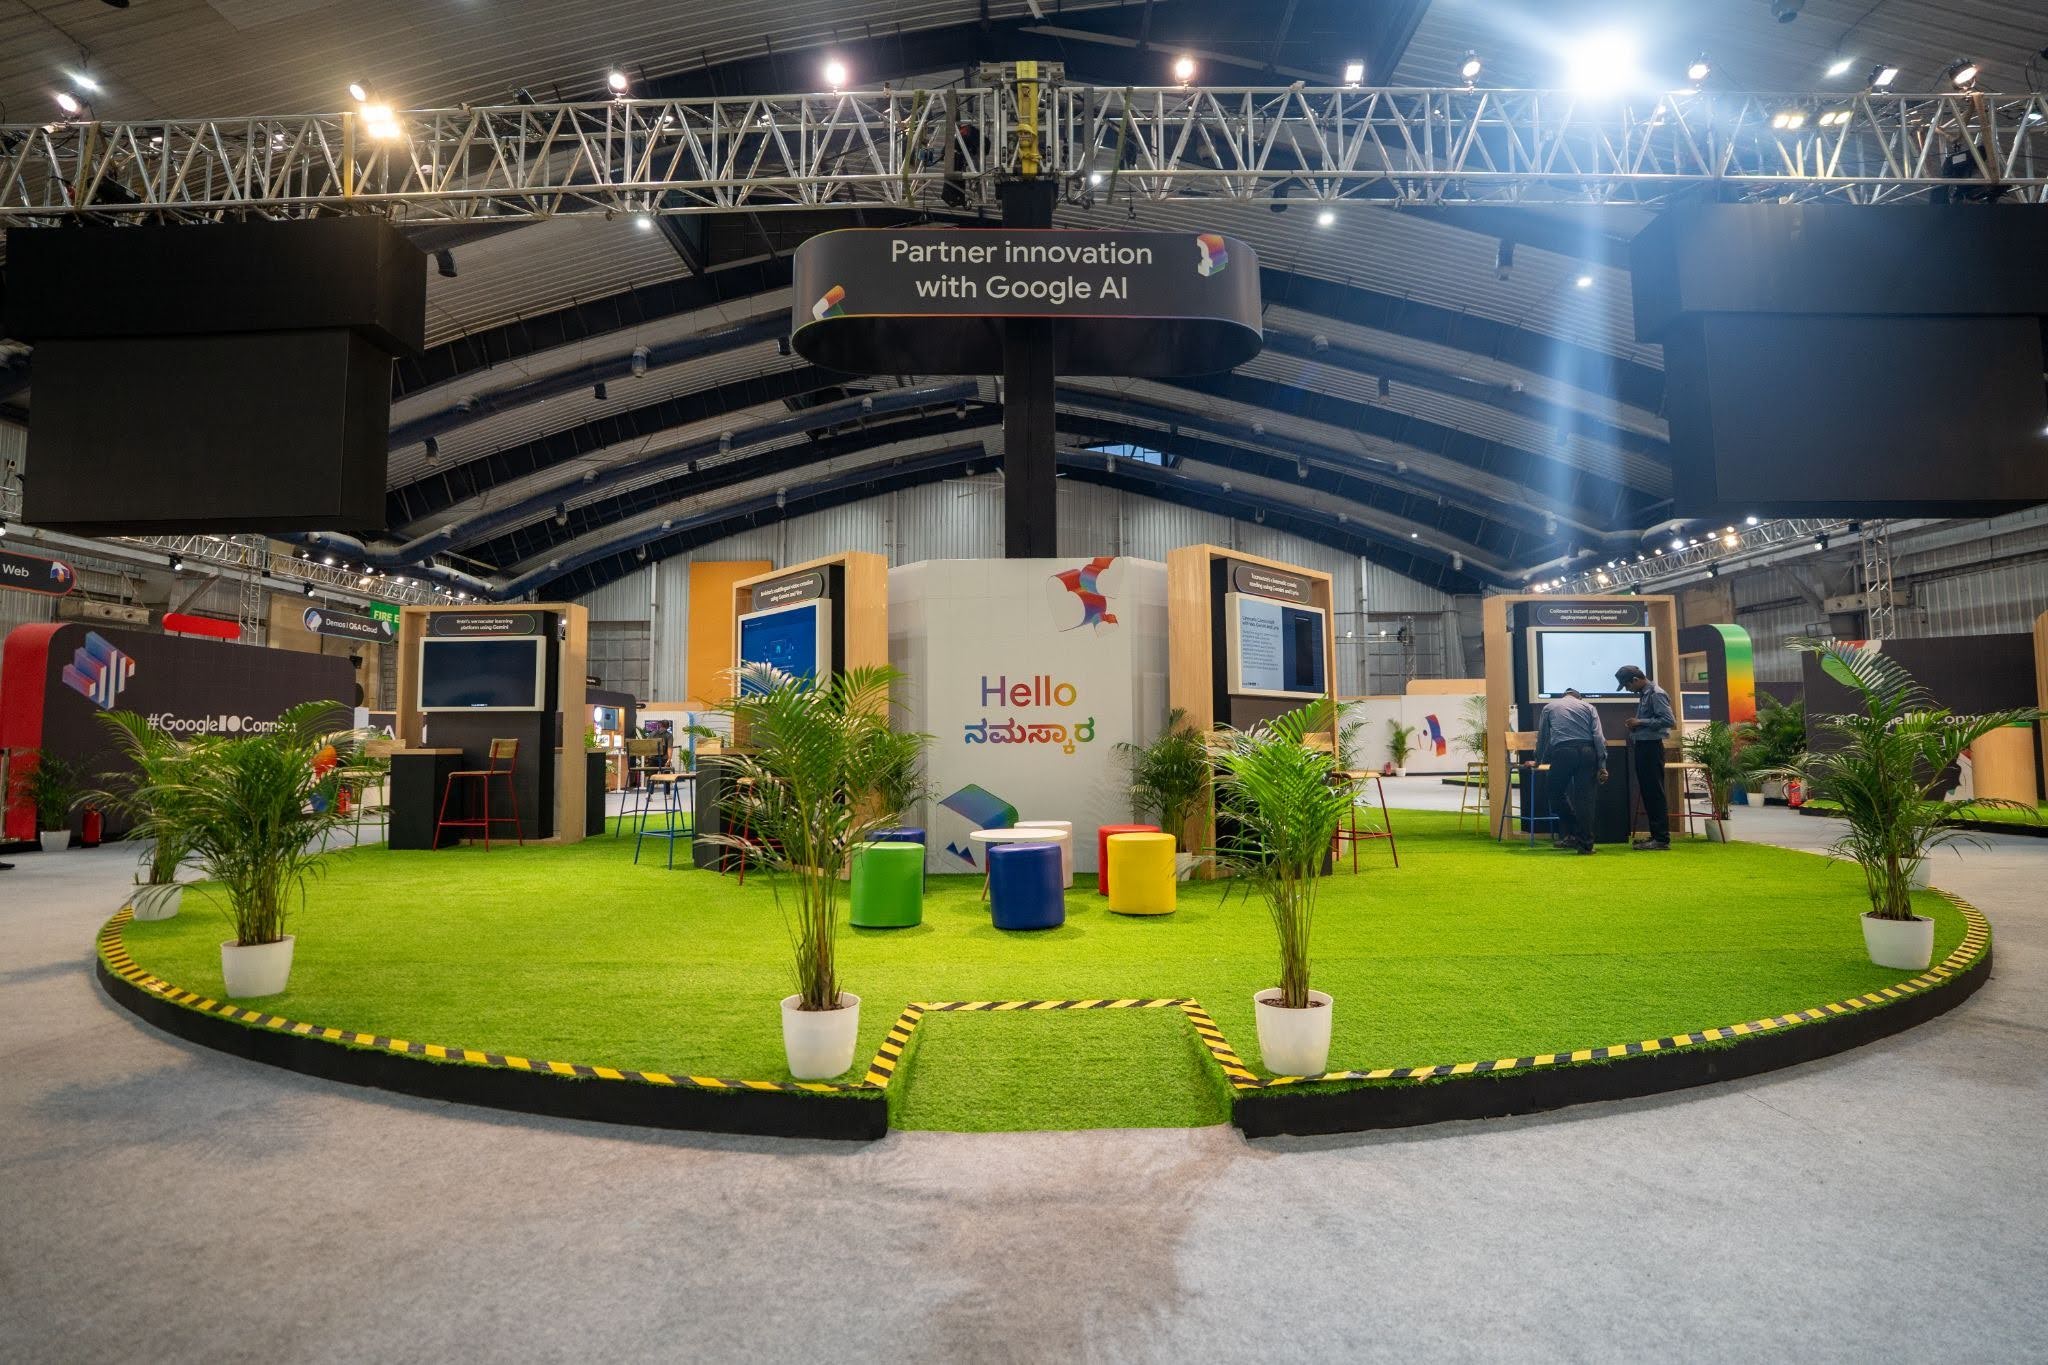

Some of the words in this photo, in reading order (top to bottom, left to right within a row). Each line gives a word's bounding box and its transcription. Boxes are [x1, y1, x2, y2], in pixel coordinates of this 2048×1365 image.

[891, 240, 997, 264] Partner
[1005, 240, 1152, 265] innovation
[915, 275, 977, 298] with
[986, 275, 1091, 305] Google
[1100, 276, 1128, 299] AI
[2, 564, 29, 577] Web
[326, 618, 346, 629] Demos
[362, 624, 378, 634] Cloud
[373, 610, 392, 622] FIRE
[981, 675, 1077, 707] Hello
[964, 716, 1095, 754] ನಮಸ್ಕಾರ
